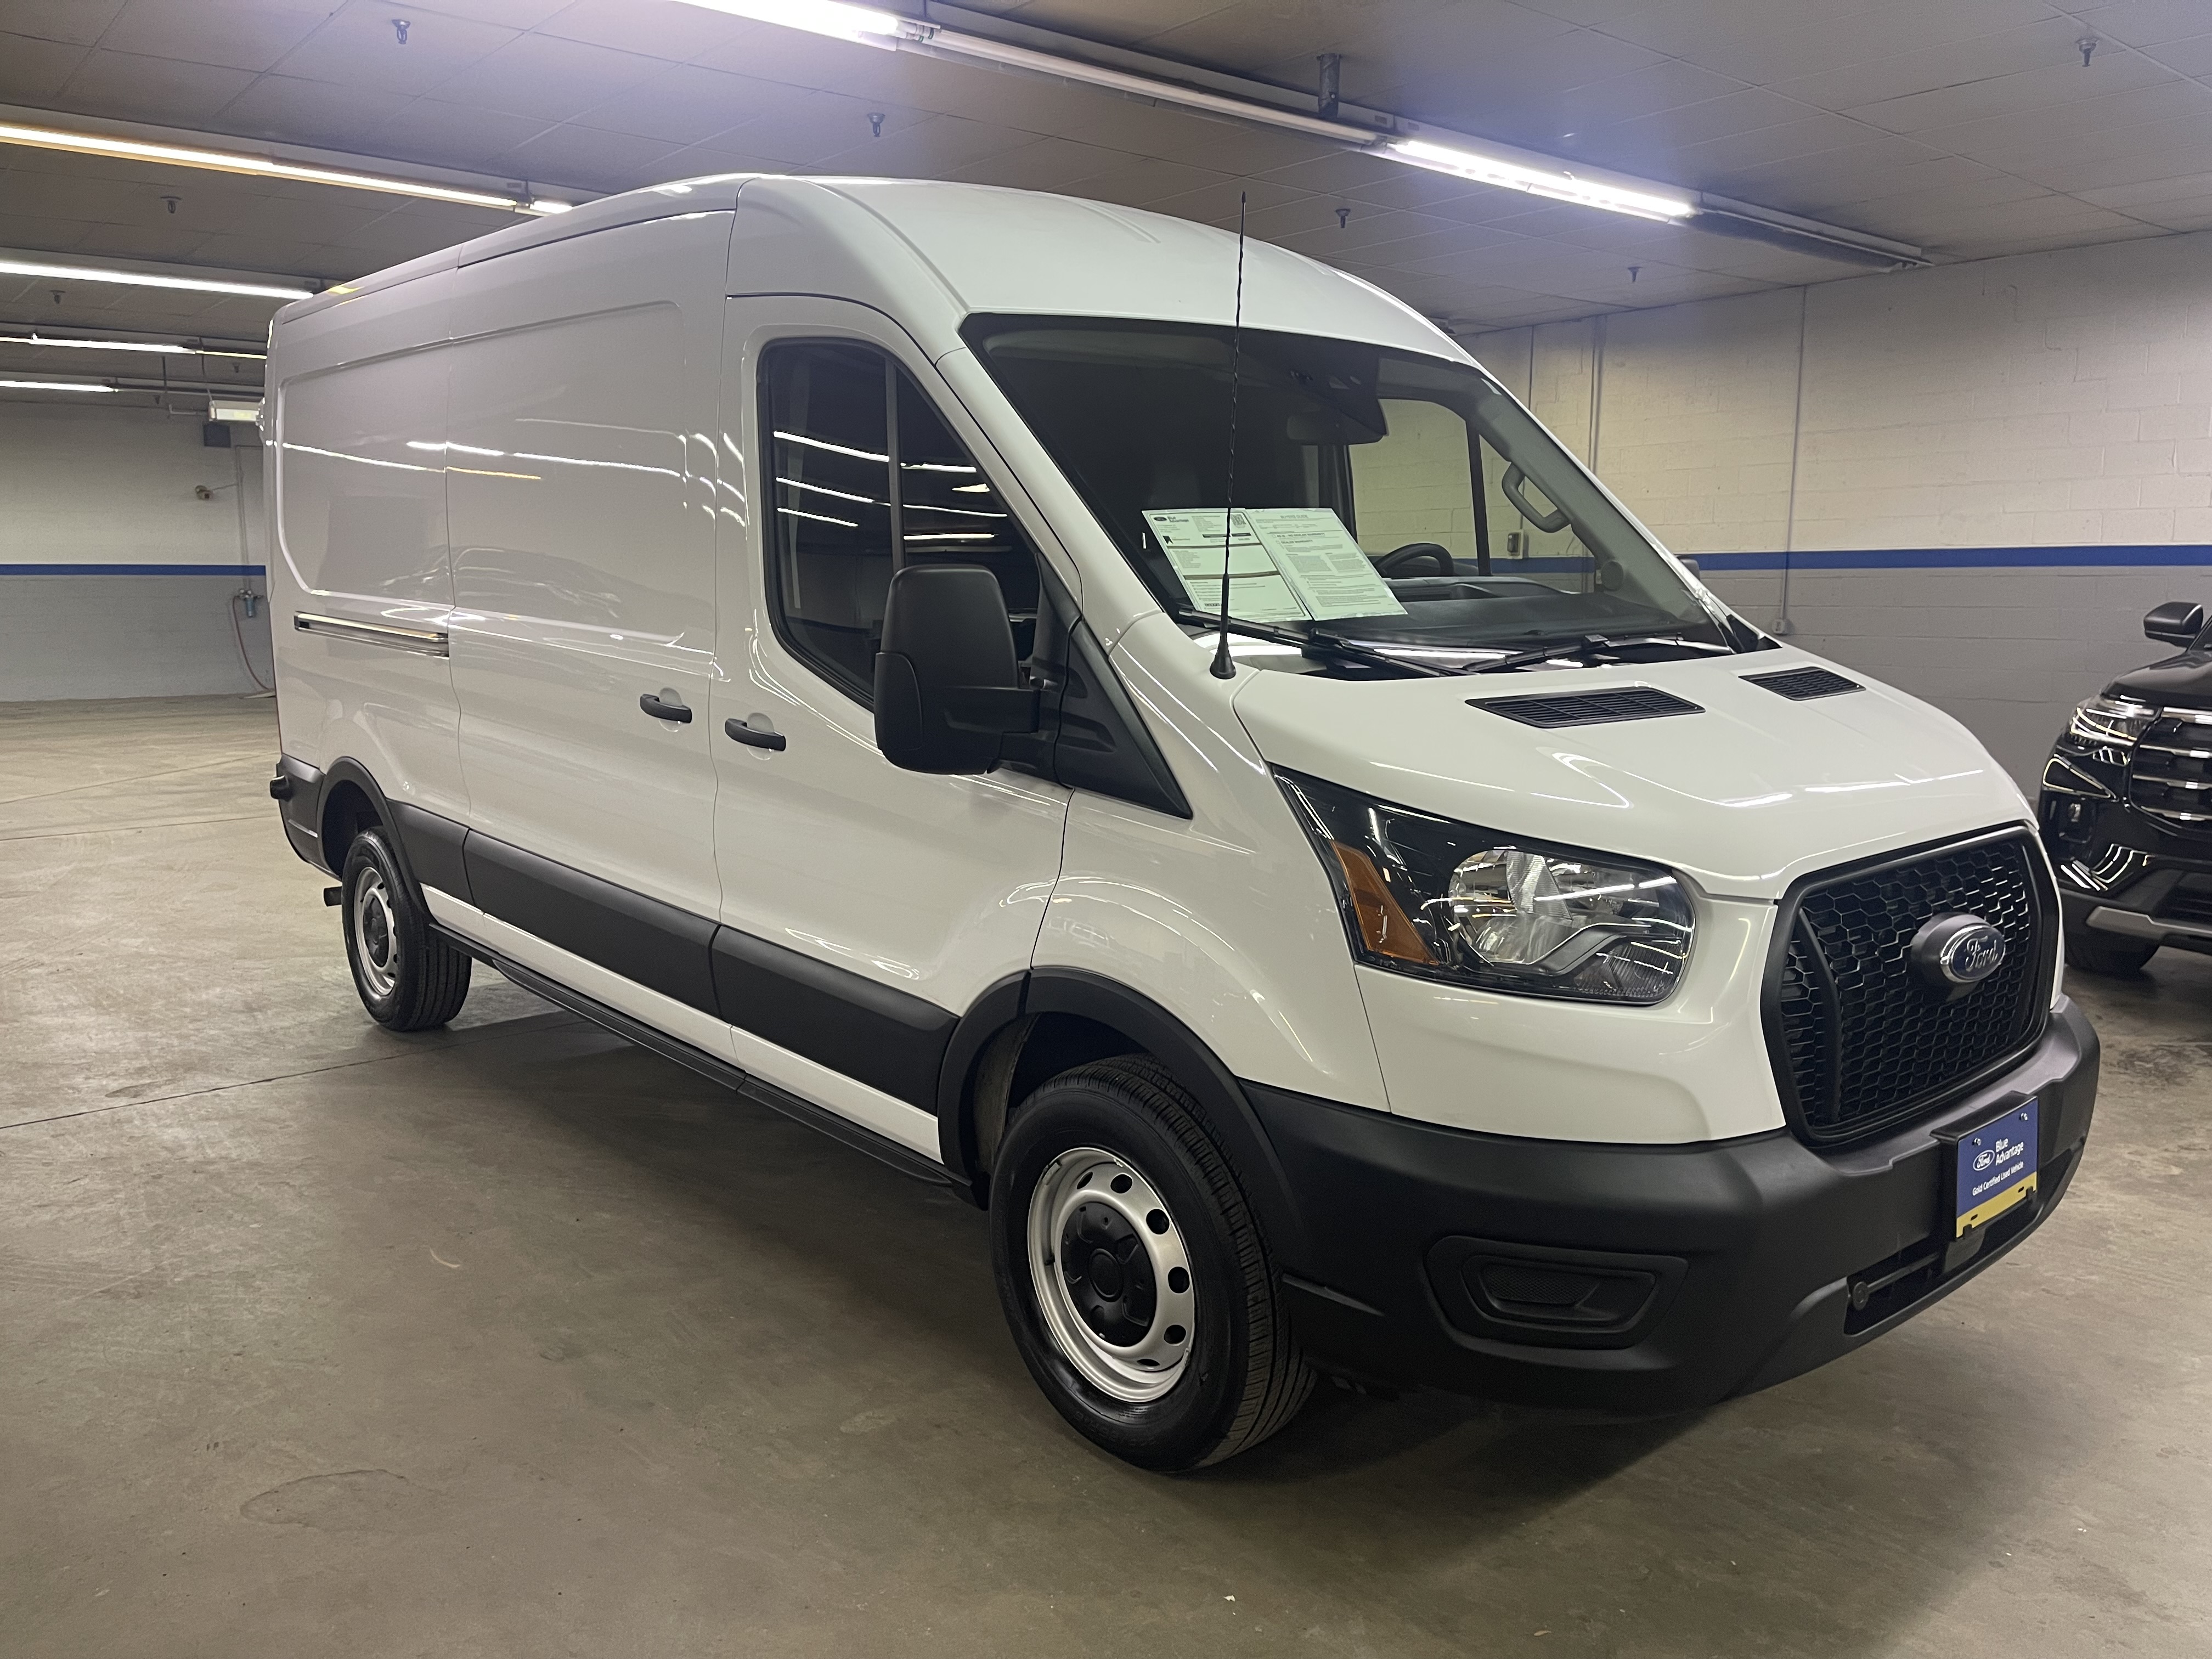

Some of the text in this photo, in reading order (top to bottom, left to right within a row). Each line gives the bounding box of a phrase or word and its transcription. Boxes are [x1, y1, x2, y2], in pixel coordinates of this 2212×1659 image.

[1965, 935, 1999, 972] Ford
[1995, 1138, 2008, 1153] Blue
[1995, 1142, 2024, 1166] Advantage
[1972, 1161, 2024, 1196] Gold Certified Used Vehicle
